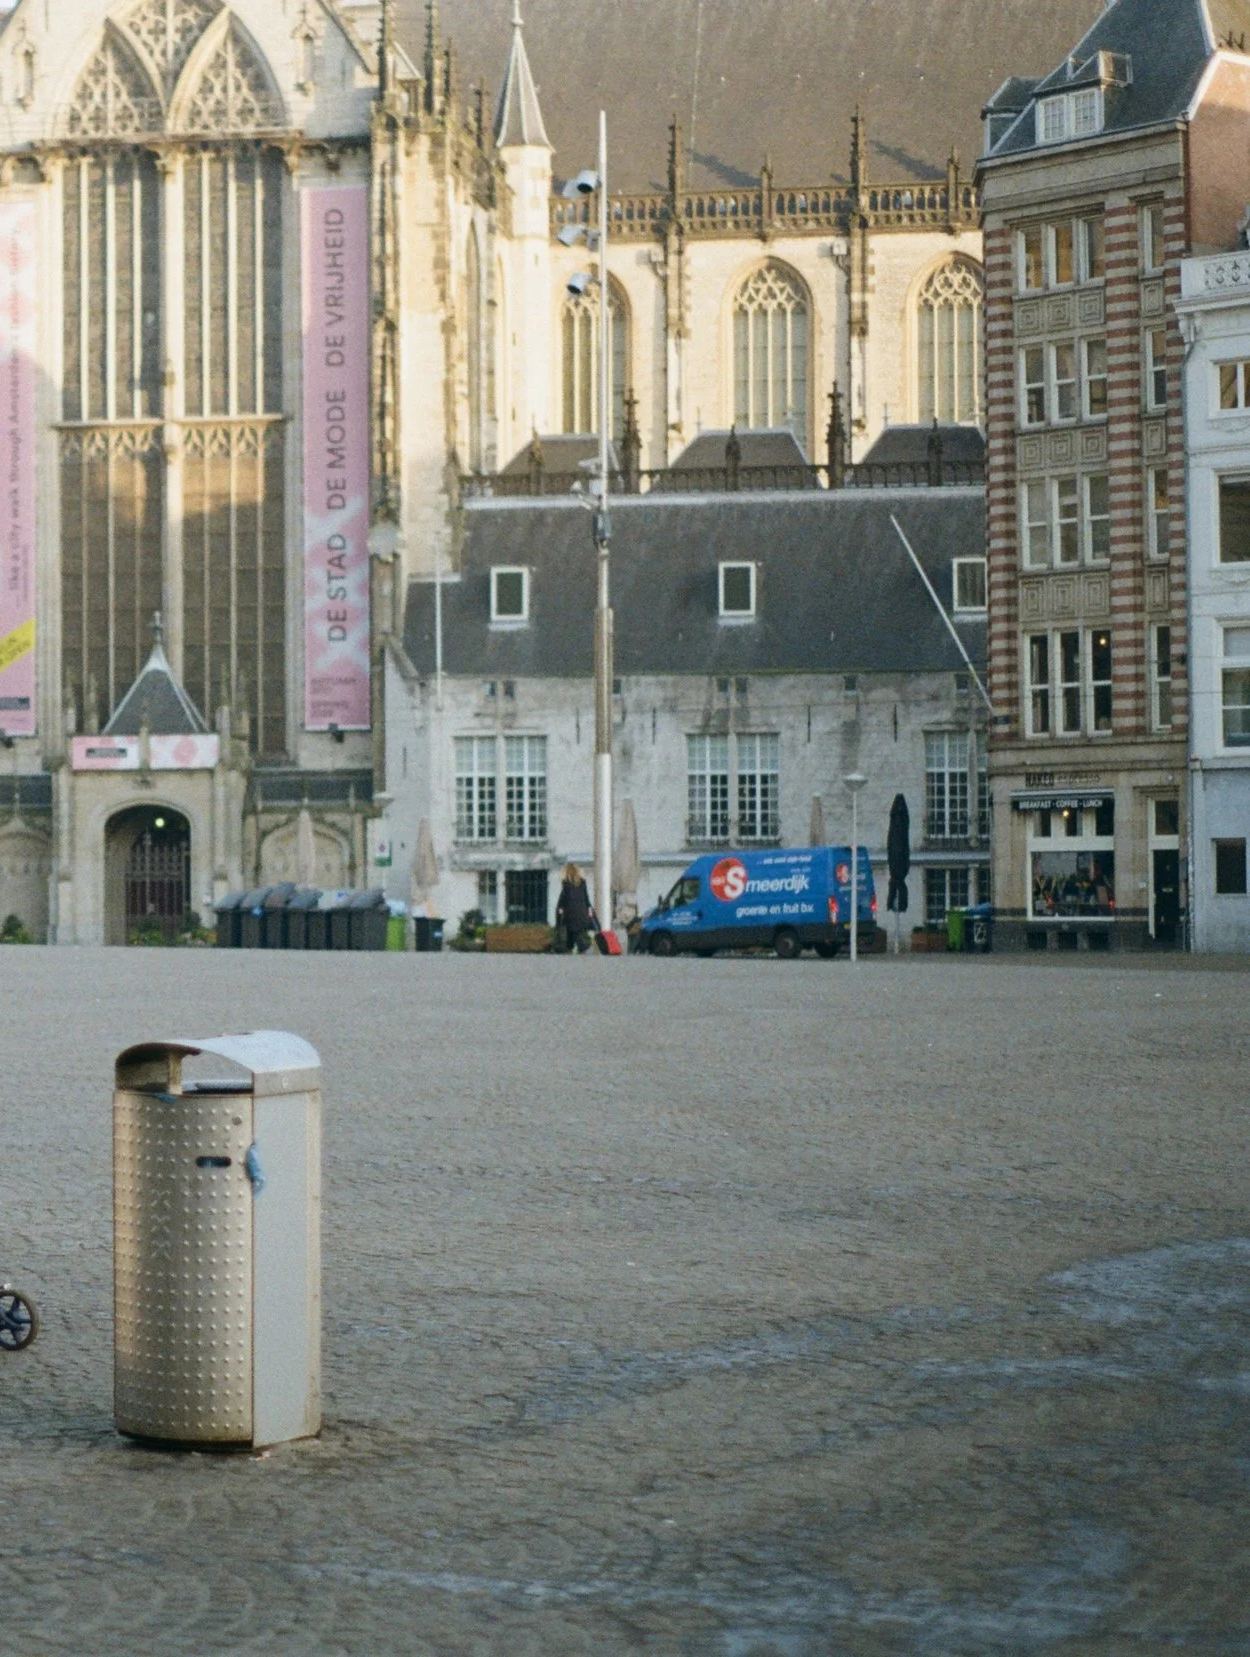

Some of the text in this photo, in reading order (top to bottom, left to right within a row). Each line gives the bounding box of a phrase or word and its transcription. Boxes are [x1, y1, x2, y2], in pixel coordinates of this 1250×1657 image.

[324, 208, 347, 642] DE STAD DE MODE DE VRIJHEID
[8, 427, 24, 482] through
[8, 488, 21, 519] walk
[8, 566, 21, 591] like
[1019, 800, 1103, 809] BREAKFAST COFFEE LUNCH
[724, 866, 810, 899] Smeerdijk
[736, 905, 768, 919] groente
[769, 905, 782, 915] en
[782, 903, 799, 914] fruit
